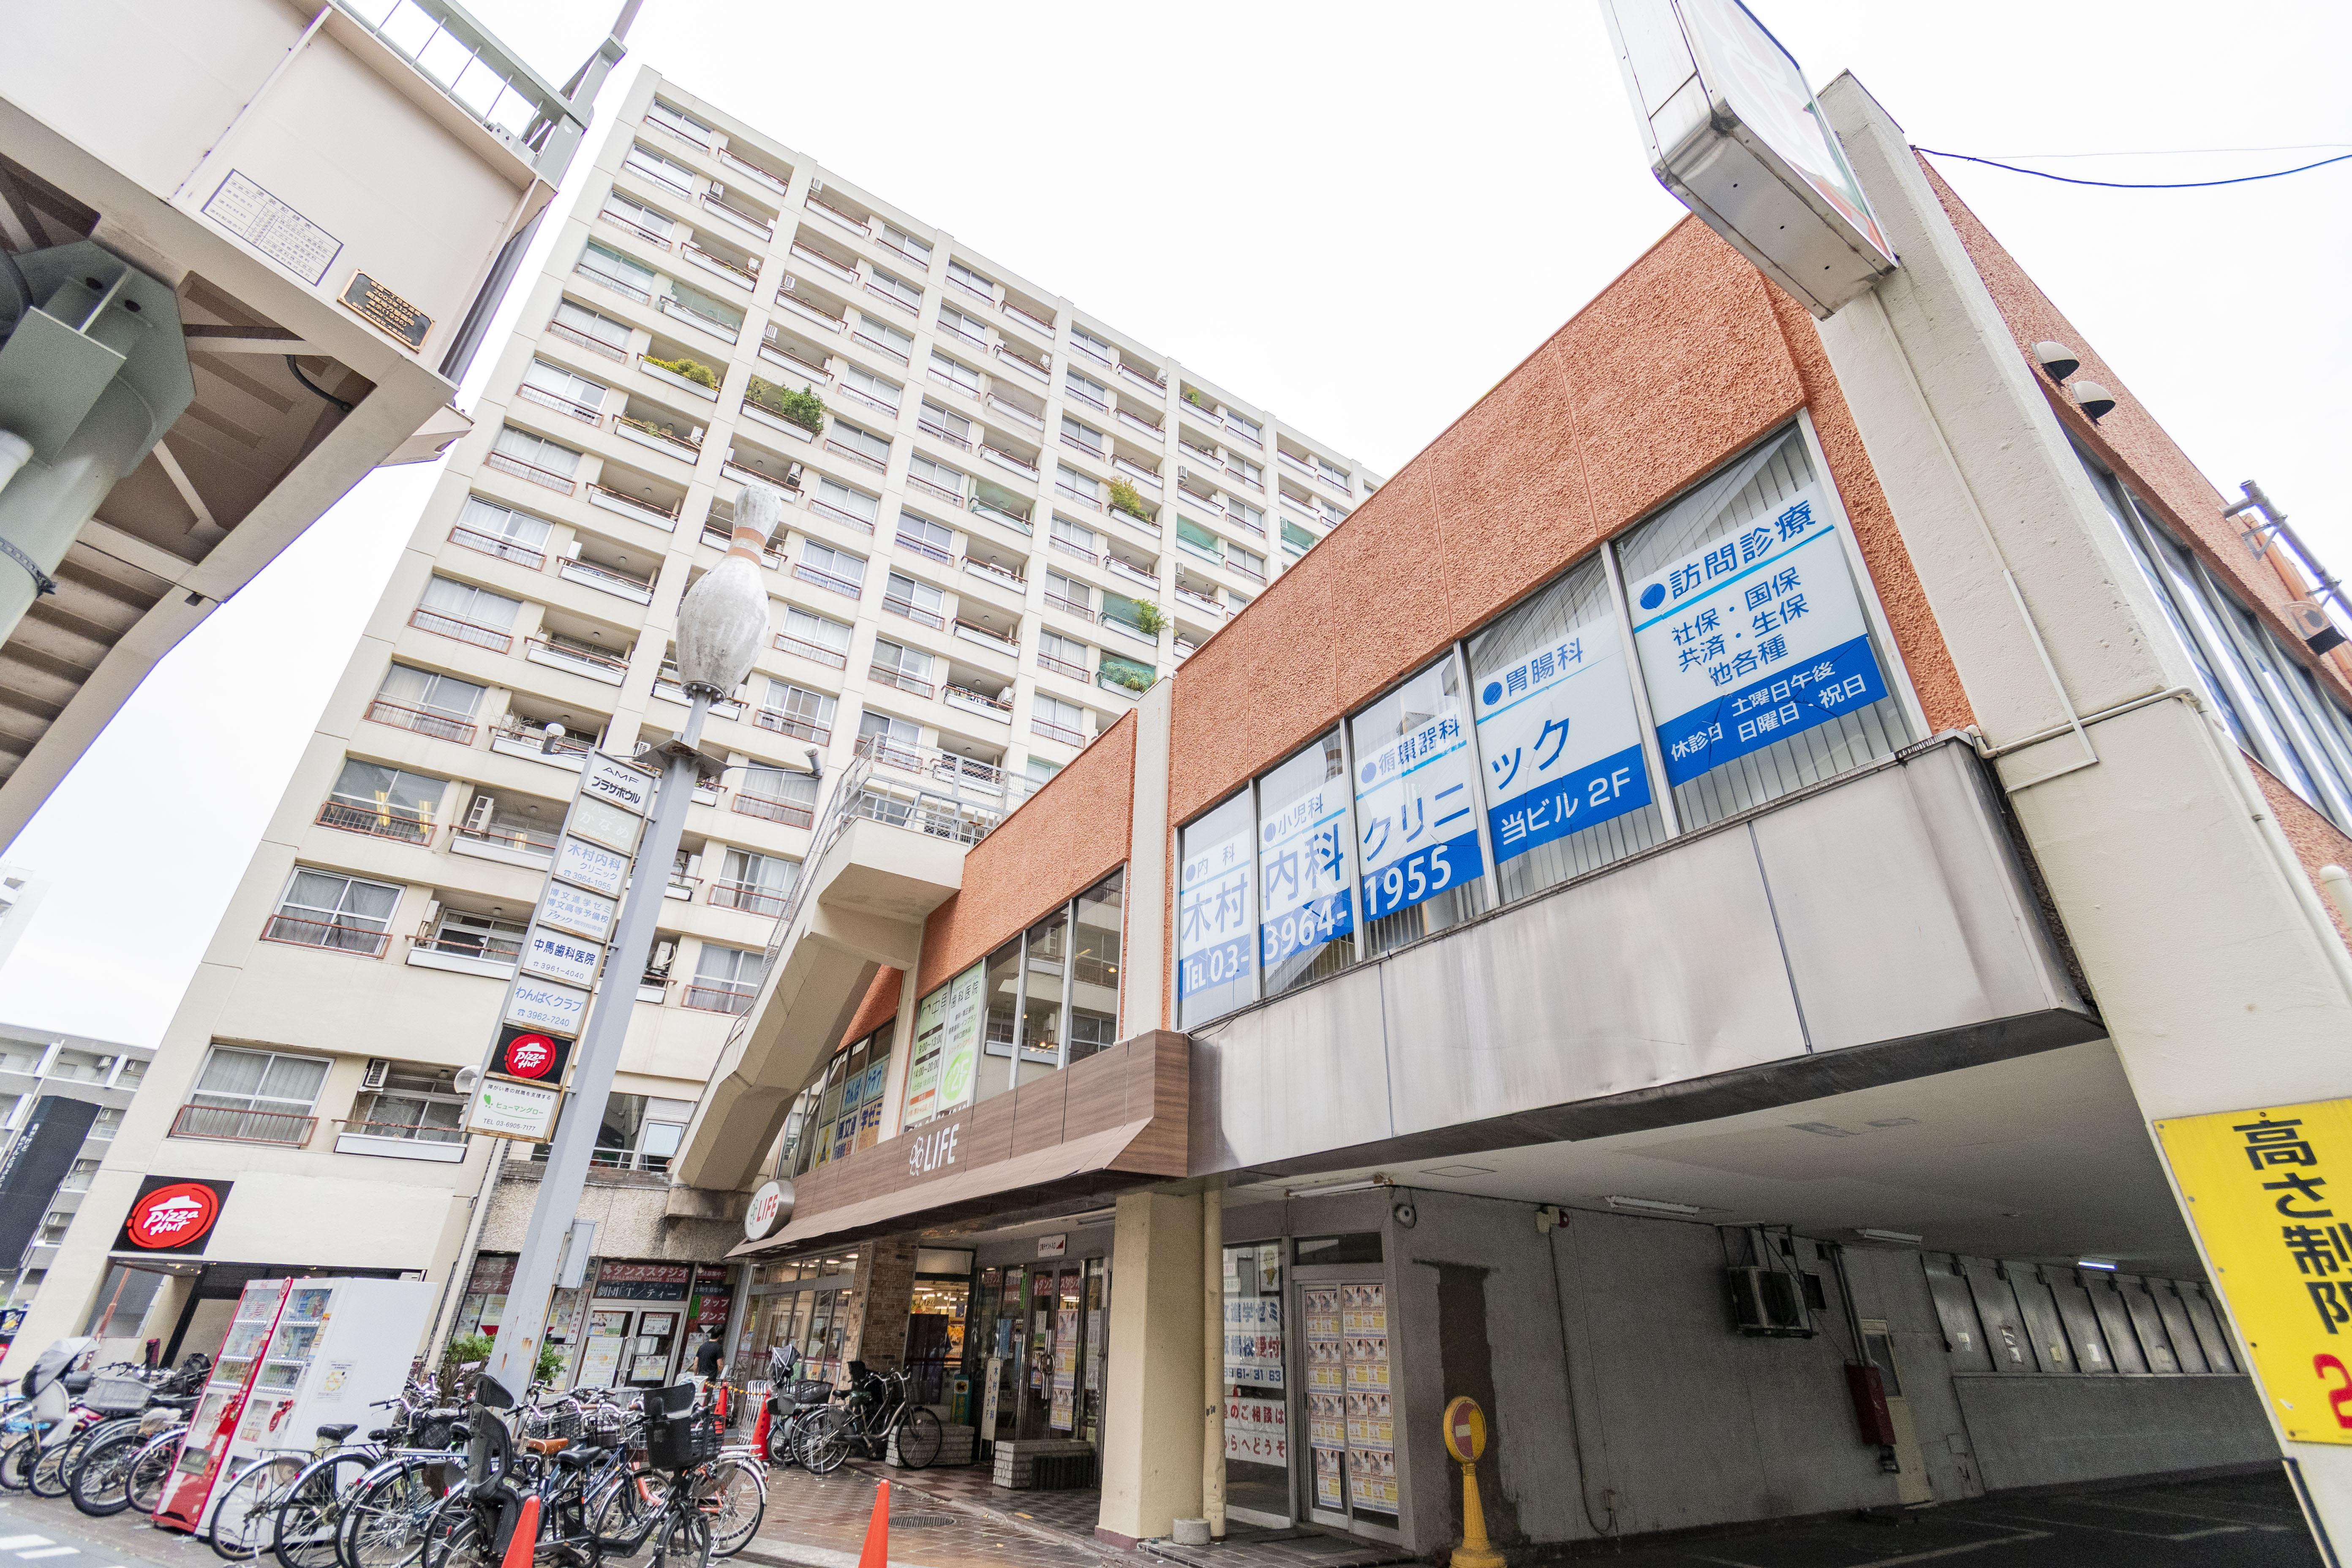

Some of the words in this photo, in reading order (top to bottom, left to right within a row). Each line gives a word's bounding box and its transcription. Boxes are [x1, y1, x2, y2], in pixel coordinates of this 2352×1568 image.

[255, 189, 312, 230] 塗装記録表
[365, 290, 415, 326] 関東地方整備局
[373, 289, 413, 318] 2003年12月
[1670, 499, 1816, 599] 訪問診療
[1672, 566, 1801, 646] 社保・国保
[1678, 593, 1809, 672] 共済・生保
[1506, 637, 1583, 696] 胃腸科
[1709, 634, 1788, 686] 他各種
[1731, 661, 1836, 717] 土曜日午後
[1737, 673, 1867, 742] 日曜日・祝日
[1379, 714, 1460, 775] 循環器科
[1671, 722, 1723, 761] 休診日
[603, 767, 639, 783] AMF
[592, 776, 640, 804] プラザボウル
[591, 803, 625, 820] パーラー
[1277, 796, 1323, 837] 小児科
[1501, 792, 1578, 845] 当ビル
[1588, 767, 1631, 807] 2F
[579, 811, 629, 838] かなめ
[568, 844, 621, 871] 木村内科
[580, 862, 617, 880] クリニック
[572, 872, 612, 890] 3964-1955
[547, 897, 609, 924] 博文高等予備校
[550, 887, 611, 914] 博文進学ゼミ
[545, 909, 573, 924] アタック
[534, 939, 596, 966] 中馬歯科医院
[541, 963, 584, 980] 3961-4040
[515, 986, 584, 1012] わんぱくクラブ
[527, 1010, 570, 1027] 3962-7240
[514, 1051, 546, 1063] Pizza
[517, 1059, 541, 1069] Hut
[487, 1084, 551, 1100] 障がい者の就職を支援する
[845, 1065, 883, 1105] わんぱクラブ
[496, 1102, 544, 1115] ヒューマングロー
[496, 1120, 536, 1132] 03-6905-7177
[923, 1124, 960, 1171] LIFE
[143, 1209, 199, 1229] Pizza
[757, 1194, 779, 1222] LIFE
[148, 1219, 191, 1236] Hut
[613, 1266, 689, 1278] ダンススタジオ
[700, 1311, 726, 1321] ダンス
[703, 1298, 730, 1307] タップ
[990, 1366, 999, 1421] 木村内科
